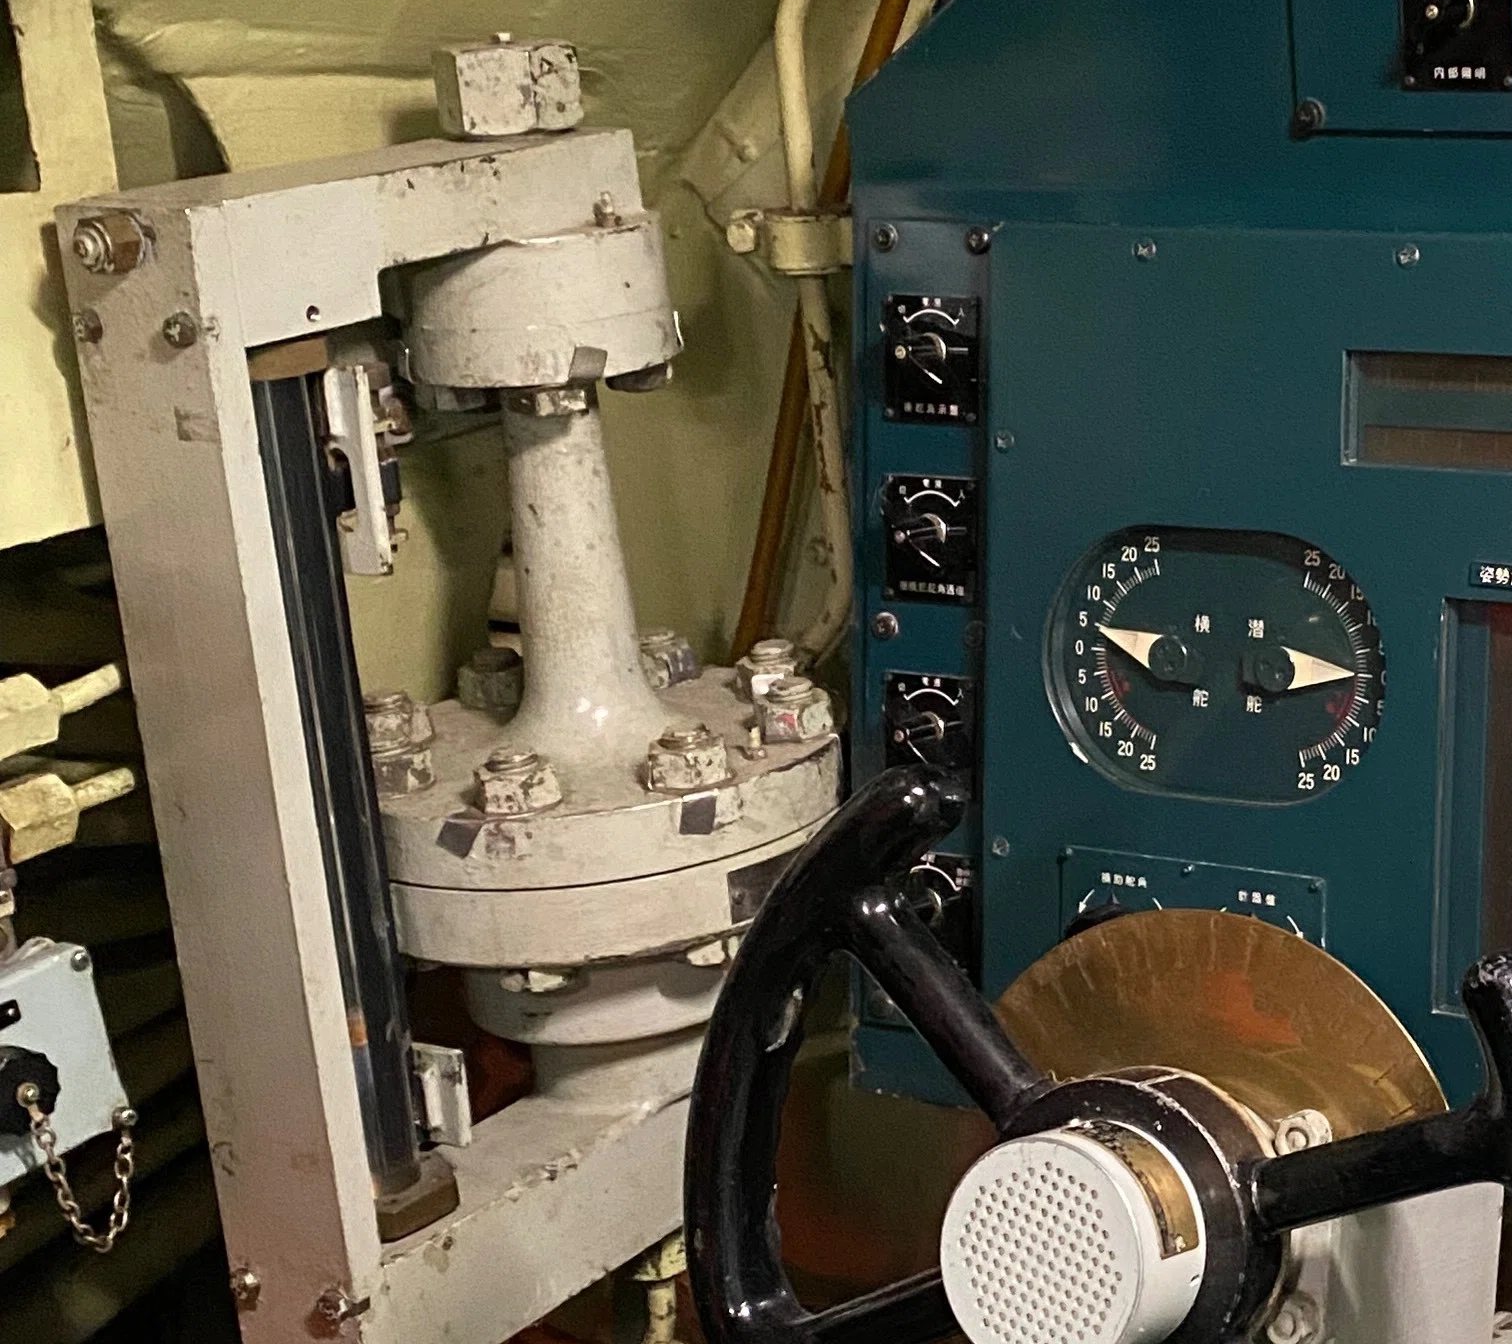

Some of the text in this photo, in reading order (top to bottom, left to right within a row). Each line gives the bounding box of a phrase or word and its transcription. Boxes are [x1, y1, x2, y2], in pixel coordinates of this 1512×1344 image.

[1144, 536, 1160, 553] 25
[1122, 546, 1137, 562] 20
[1304, 549, 1320, 567] 25
[1102, 563, 1115, 579] 15
[1329, 563, 1345, 580] 20
[1088, 585, 1100, 601] 10
[1351, 584, 1364, 601] 15
[1079, 611, 1088, 627] 5
[1075, 640, 1084, 655] 0
[1193, 614, 1210, 707] 横 舵
[1246, 619, 1264, 714] 潜 舵
[1078, 669, 1086, 684] 5
[1086, 696, 1098, 712] 10
[1099, 722, 1112, 737] 15
[1117, 740, 1133, 756] 20
[1140, 754, 1156, 770] 25
[1346, 748, 1360, 765] 15
[1323, 764, 1341, 781] 20
[1298, 772, 1315, 790] 25
